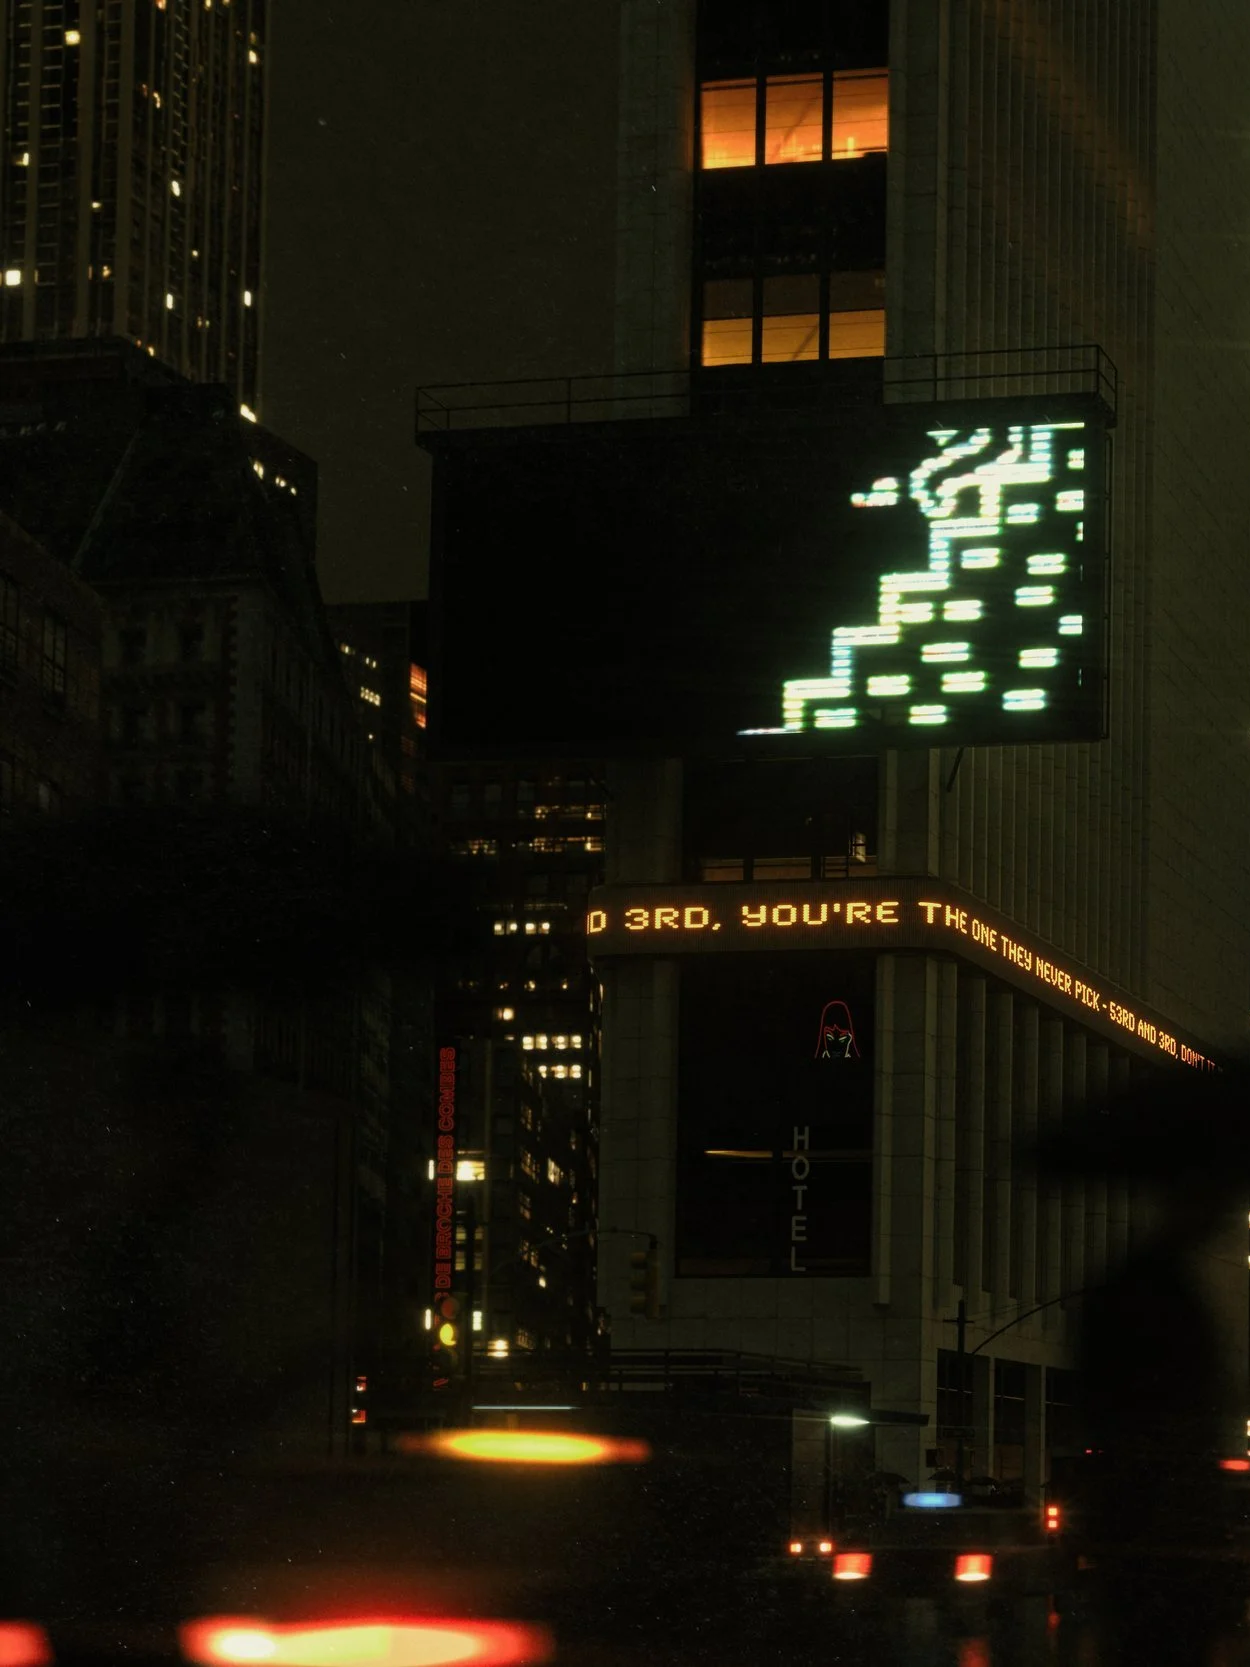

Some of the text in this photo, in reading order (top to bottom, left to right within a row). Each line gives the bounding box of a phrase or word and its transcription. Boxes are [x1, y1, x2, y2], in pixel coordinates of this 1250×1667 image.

[587, 911, 607, 933] D
[625, 908, 721, 931] 3RD,
[742, 901, 899, 927] YOU'RE
[918, 901, 968, 934] THE
[972, 918, 997, 952] ONE
[1000, 935, 1032, 971] THEY
[1036, 956, 1072, 995] NEVER
[1075, 980, 1100, 1012] PICK
[1109, 1001, 1135, 1032] 53RD
[1137, 1019, 1157, 1045] AND
[1158, 1031, 1179, 1060] 3RD,
[437, 1134, 454, 1174] DES
[435, 1176, 453, 1260] BROCHE
[791, 1126, 810, 1272] HOTEL
[435, 1262, 452, 1289] DE
